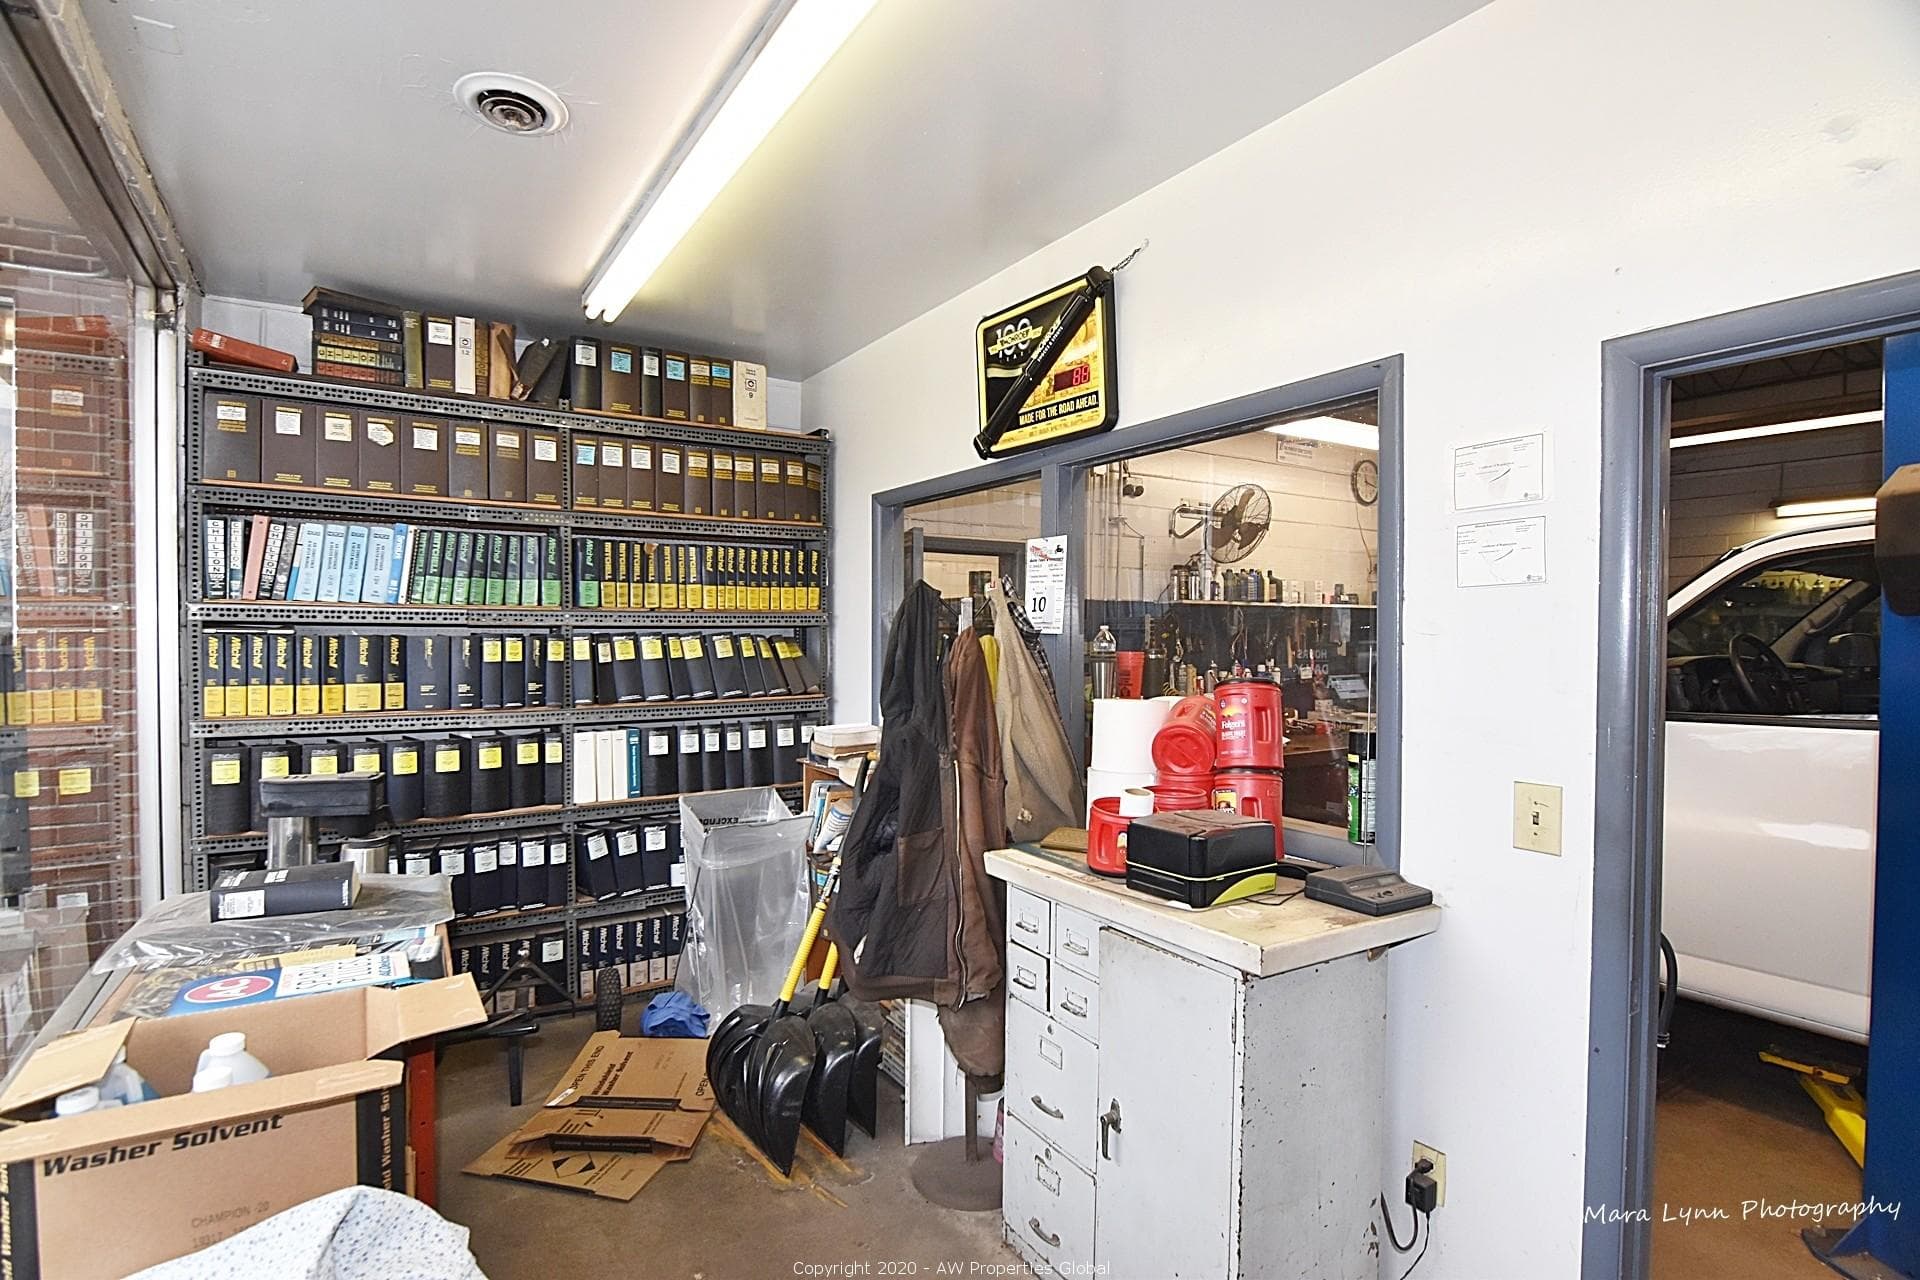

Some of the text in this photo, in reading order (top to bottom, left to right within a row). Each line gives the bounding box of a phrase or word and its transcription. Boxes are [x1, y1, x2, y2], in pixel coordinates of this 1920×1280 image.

[996, 318, 1031, 359] 100
[319, 349, 375, 362] CHILTON
[318, 366, 375, 378] CHILTON
[1019, 411, 1034, 425] MADE
[1035, 408, 1046, 421] FOR
[1046, 405, 1058, 418] THE
[1059, 400, 1075, 415] ROAD
[265, 525, 281, 574] CHILTON
[1031, 596, 1047, 613] 10
[208, 636, 219, 670] Mitchell
[231, 636, 241, 670] Mitchell
[252, 636, 263, 669] Mitchell
[276, 636, 287, 669] Mitchell
[302, 637, 313, 669] Mitchell
[328, 637, 339, 669] Mitchell
[359, 636, 368, 666] Mitchell
[390, 637, 399, 665] Mitchell
[206, 978, 253, 999] AC
[43, 1113, 283, 1177] Washer Solvent
[381, 1116, 391, 1167] Washer
[0, 1197, 12, 1256] Washer
